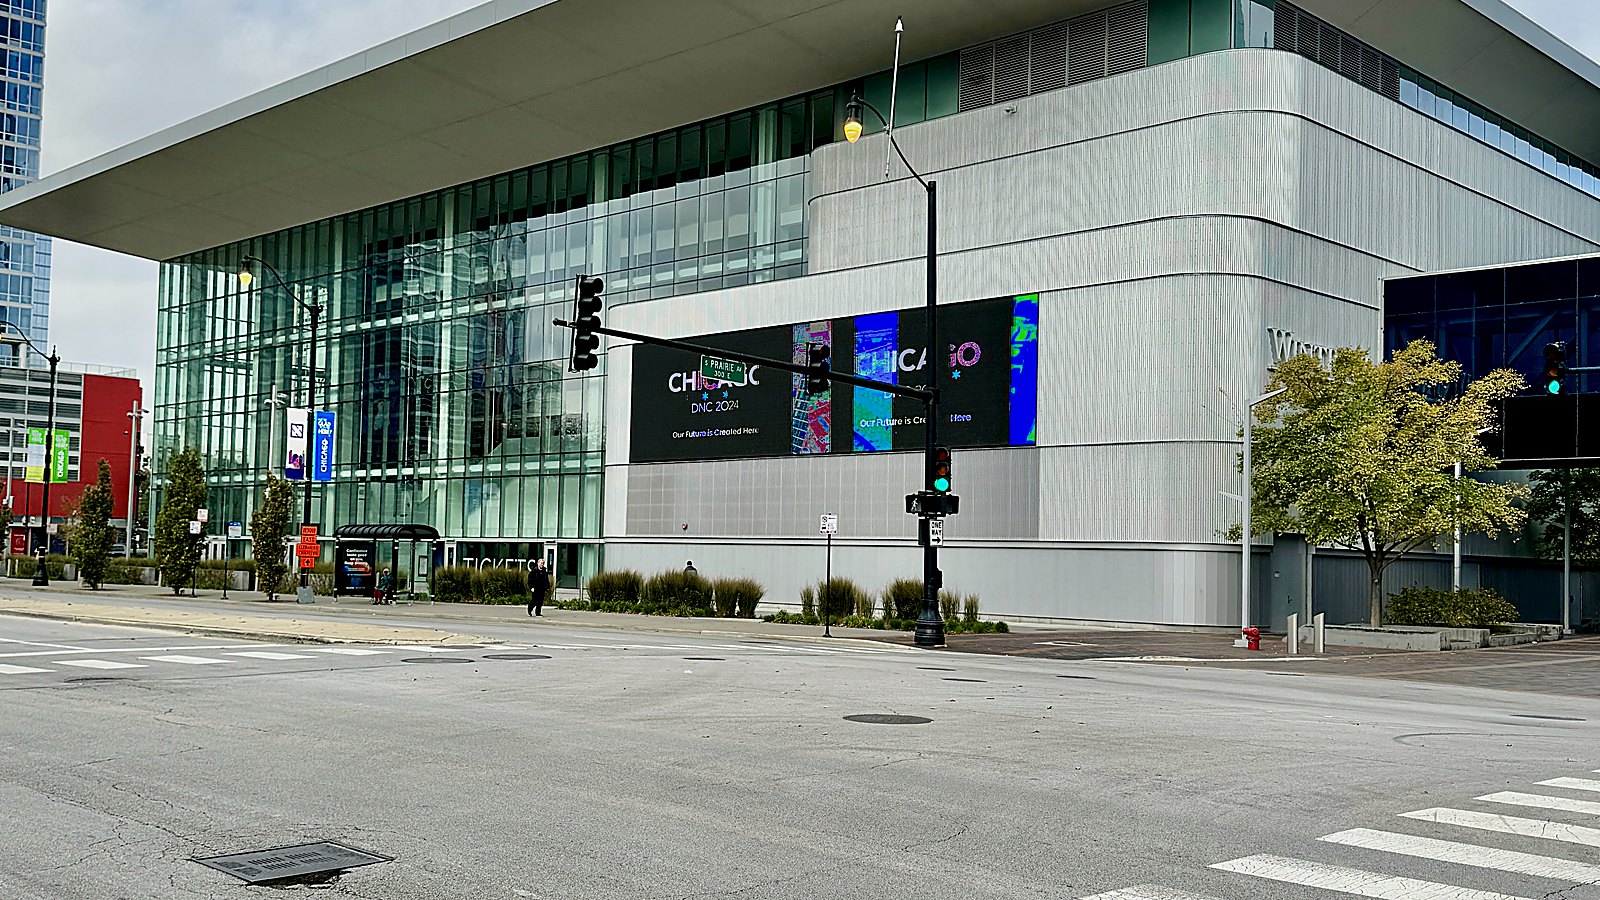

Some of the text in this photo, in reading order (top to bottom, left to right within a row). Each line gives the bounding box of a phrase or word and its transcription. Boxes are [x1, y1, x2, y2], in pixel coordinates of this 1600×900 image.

[710, 360, 734, 372] PRAIRIE
[691, 400, 739, 413] DNC 2024
[859, 419, 874, 428] Our
[876, 417, 903, 427] Future
[904, 416, 911, 425] is
[950, 414, 972, 423] Here
[672, 427, 760, 439] Our Future is Created Here
[320, 438, 329, 473] CHICAGO
[463, 557, 536, 573] TICKETS
